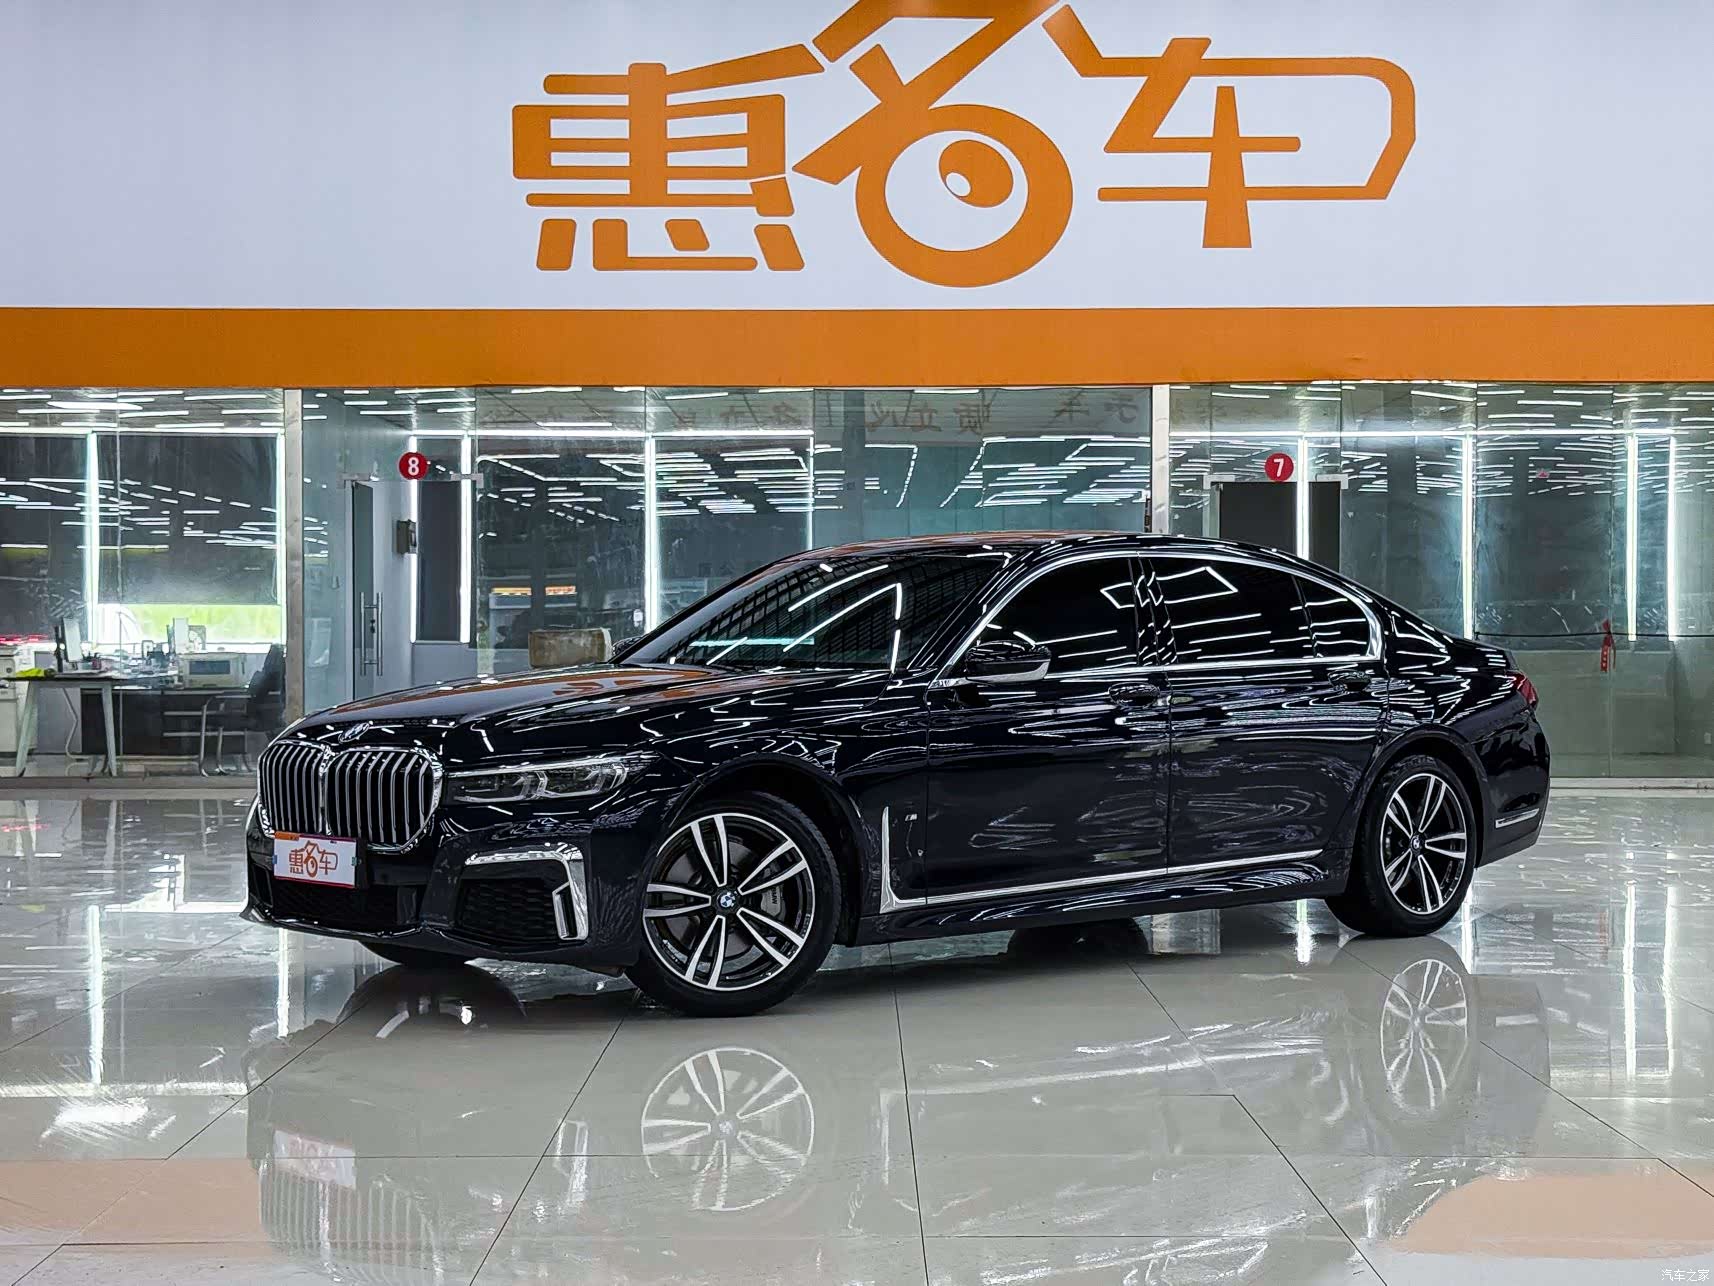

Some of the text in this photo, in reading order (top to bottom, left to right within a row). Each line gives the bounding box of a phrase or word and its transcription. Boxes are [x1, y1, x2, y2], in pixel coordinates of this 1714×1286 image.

[512, 0, 1417, 288] 惠名车
[407, 456, 420, 476] 8
[1273, 458, 1285, 478] 7
[288, 840, 339, 877] 惠名车
